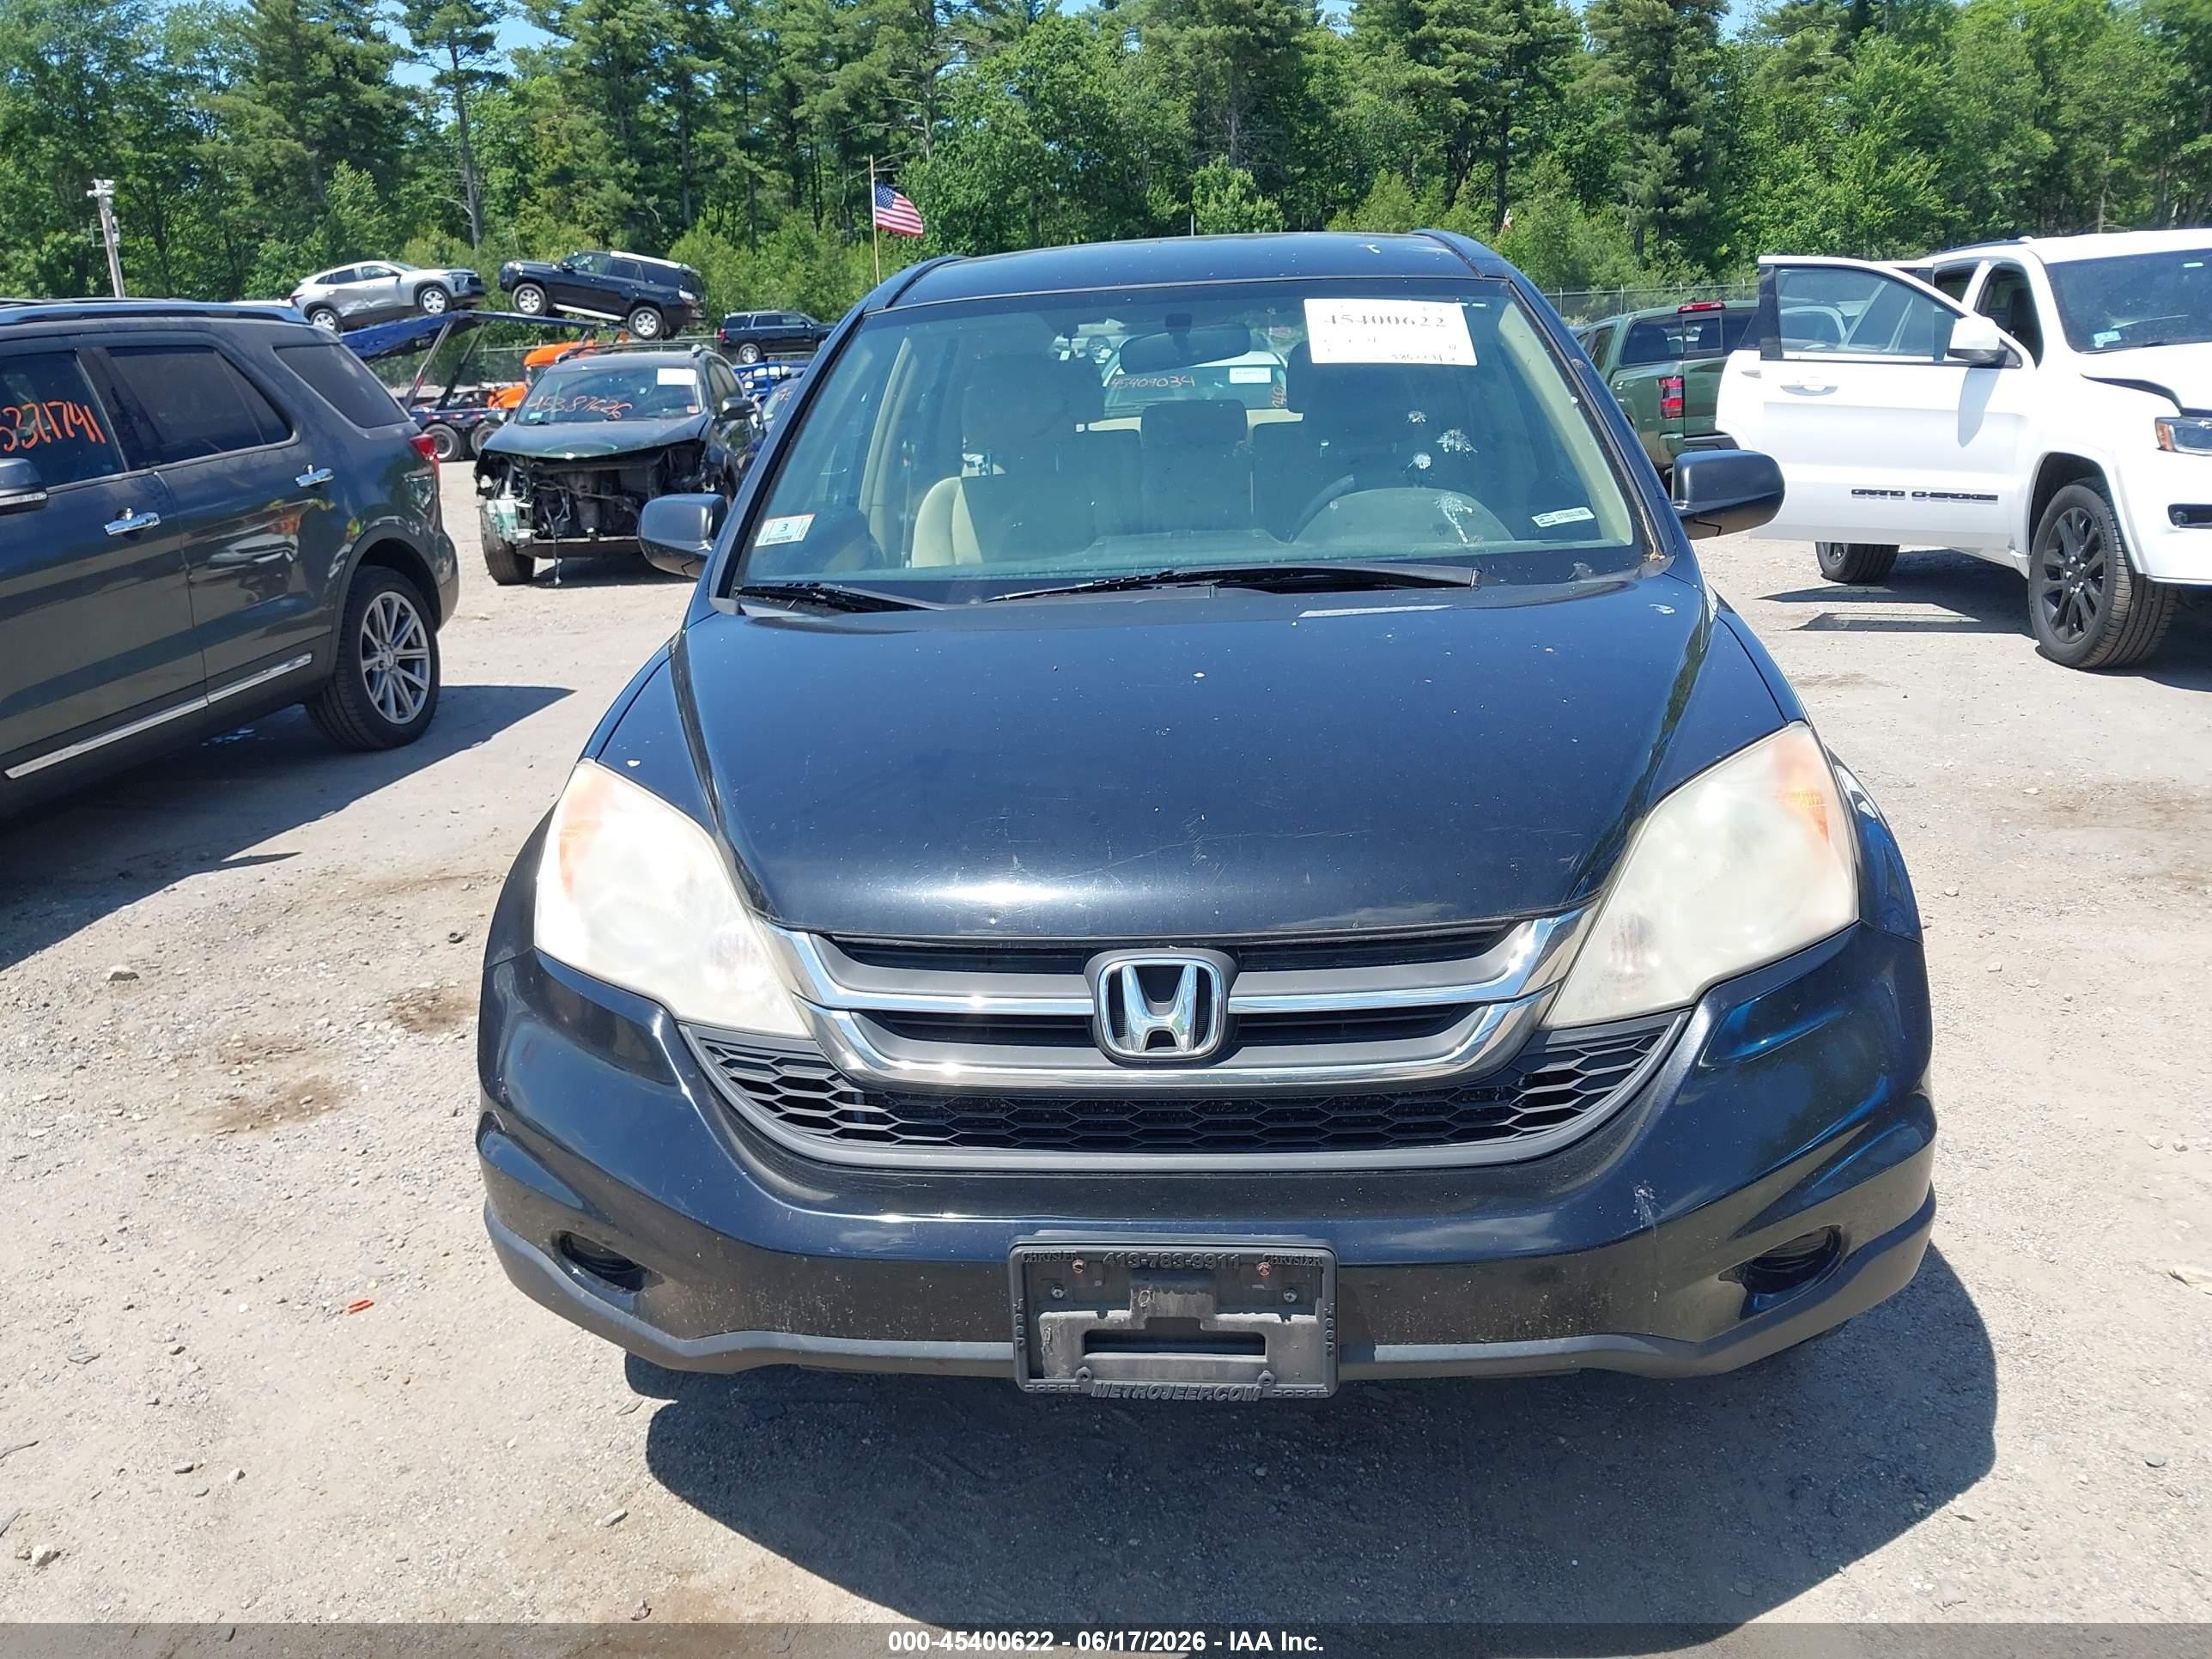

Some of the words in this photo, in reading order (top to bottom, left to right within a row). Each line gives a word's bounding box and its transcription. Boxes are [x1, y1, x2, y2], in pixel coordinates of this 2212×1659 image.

[780, 523, 789, 532] 3
[1103, 1252, 1240, 1270] 413-783-9911
[1024, 1384, 1081, 1393] DODGE
[1091, 1382, 1264, 1401] METROJEEP.COM
[1271, 1389, 1329, 1397] DODGE
